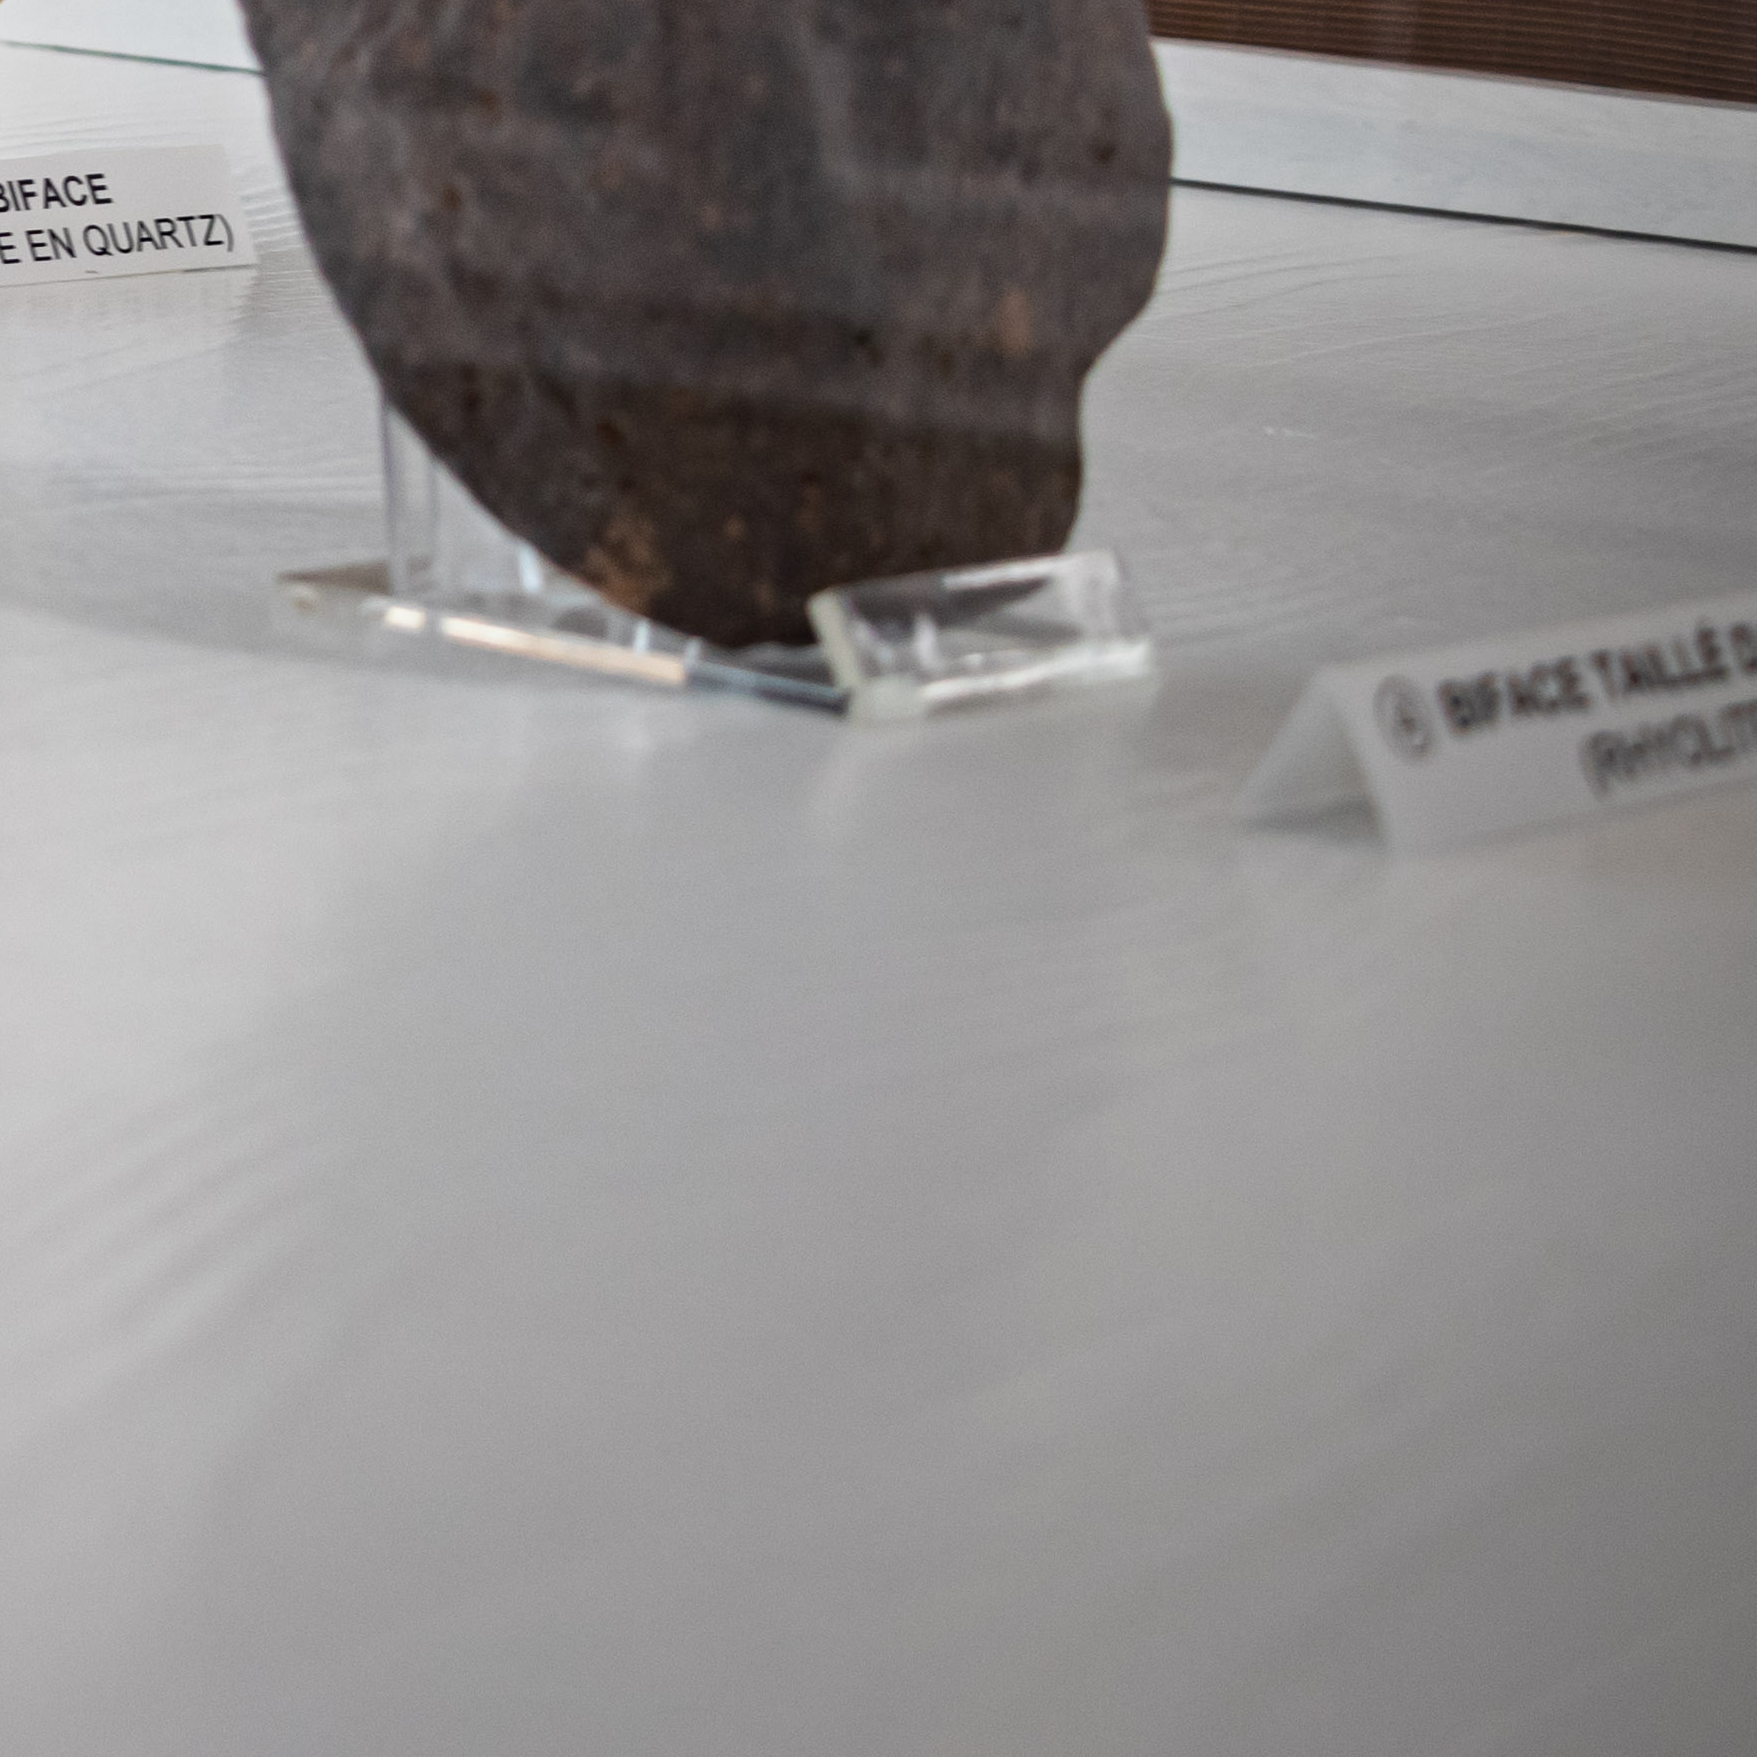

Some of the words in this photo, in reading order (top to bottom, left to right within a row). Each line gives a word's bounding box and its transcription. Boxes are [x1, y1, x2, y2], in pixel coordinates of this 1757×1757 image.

[31, 227, 75, 263] EN
[81, 212, 236, 255] QUARTZ)
[1437, 656, 1590, 737] BIFACE
